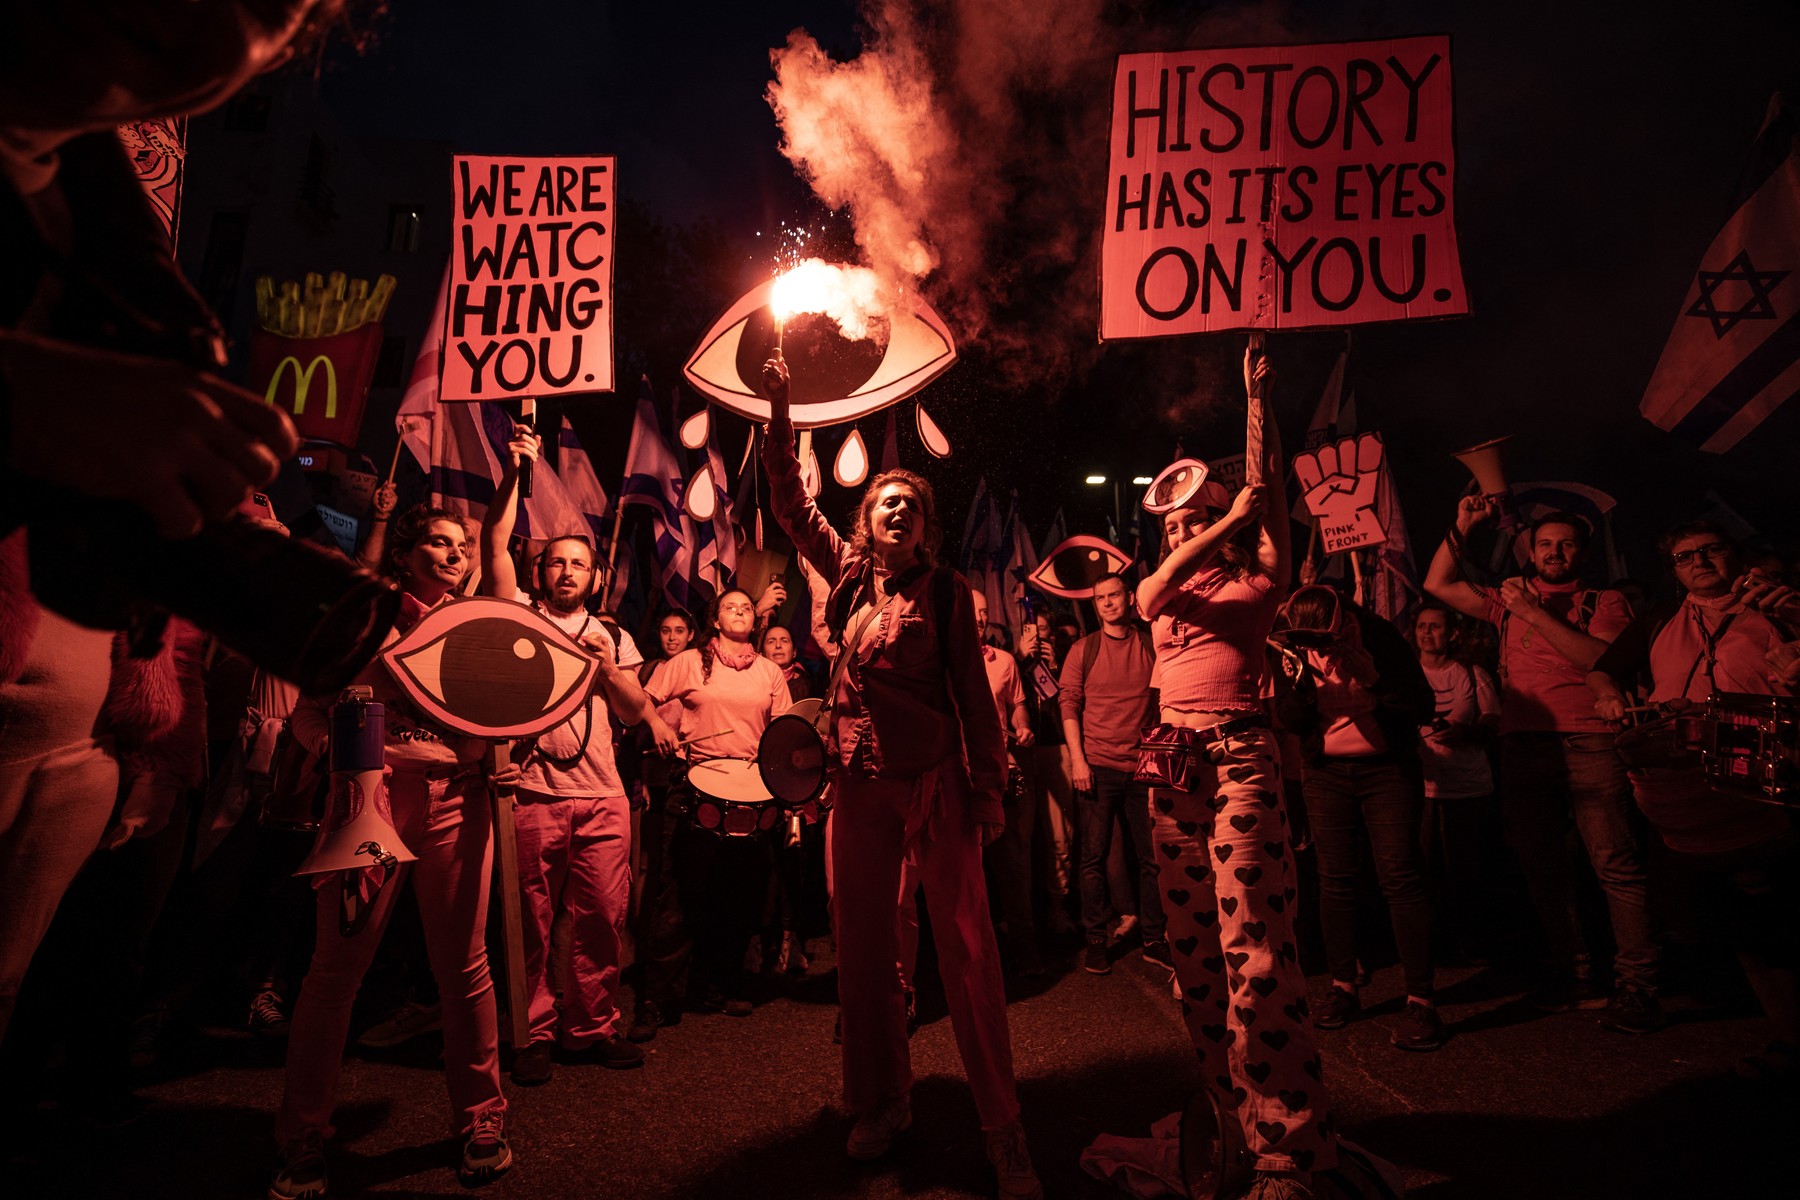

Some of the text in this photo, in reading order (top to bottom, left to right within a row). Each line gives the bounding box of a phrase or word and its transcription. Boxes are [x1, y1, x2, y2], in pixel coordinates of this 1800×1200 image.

[1126, 54, 1441, 157] HISTORY
[460, 161, 607, 220] WE ARE
[1116, 160, 1447, 232] HAS ITS EYES
[462, 221, 606, 281] WATC
[1135, 233, 1452, 321] ON YOU.
[453, 278, 603, 337] HING
[457, 334, 595, 394] YOU.
[1324, 523, 1355, 537] PINK
[1327, 532, 1368, 551] FRONT
